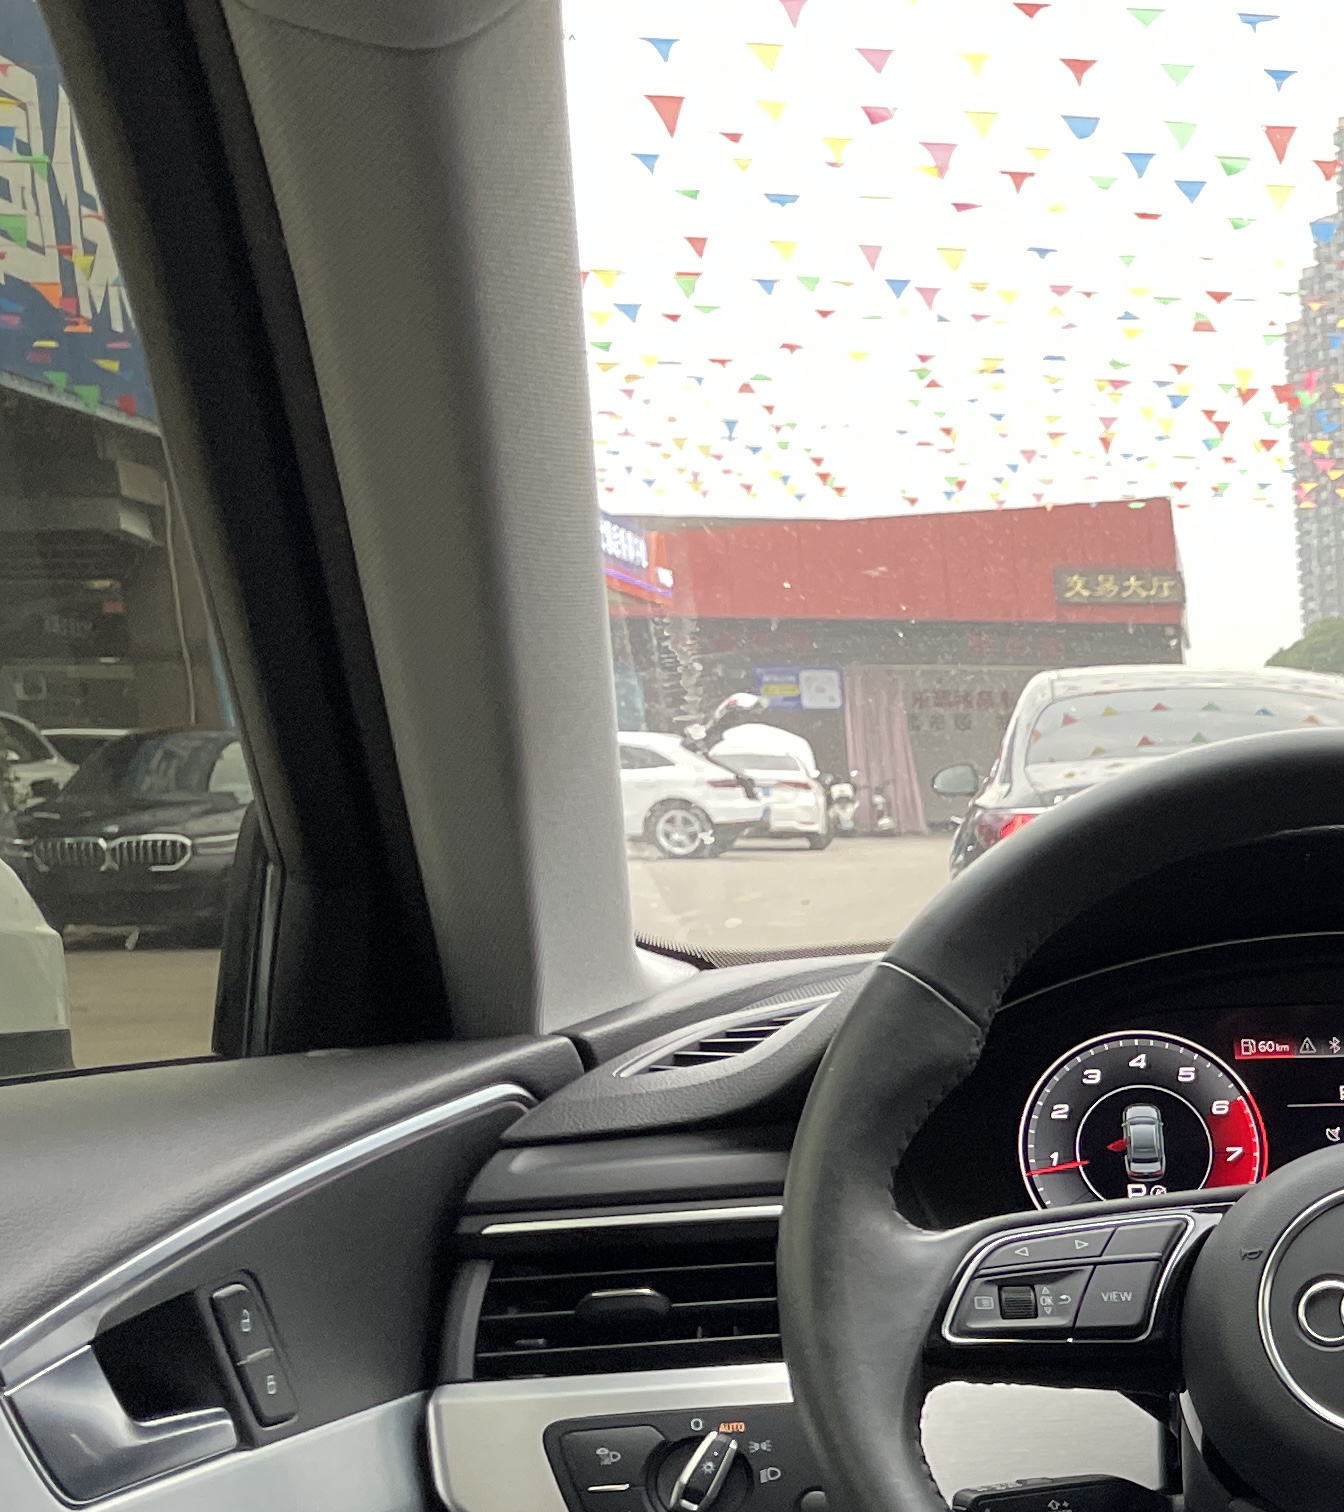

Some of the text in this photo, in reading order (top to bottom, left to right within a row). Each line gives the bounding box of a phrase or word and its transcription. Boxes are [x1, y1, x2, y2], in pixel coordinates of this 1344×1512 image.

[1064, 564, 1156, 598] 交易大厅
[1128, 1053, 1147, 1069] 4
[1082, 1068, 1101, 1084] 3
[1177, 1066, 1196, 1082] 5
[1051, 1103, 1070, 1119] 2
[1211, 1100, 1230, 1115] 6
[1050, 1151, 1060, 1167] 1
[1225, 1146, 1243, 1162] 7
[1101, 1291, 1133, 1303] VIEW
[719, 1421, 746, 1433] AUTO
